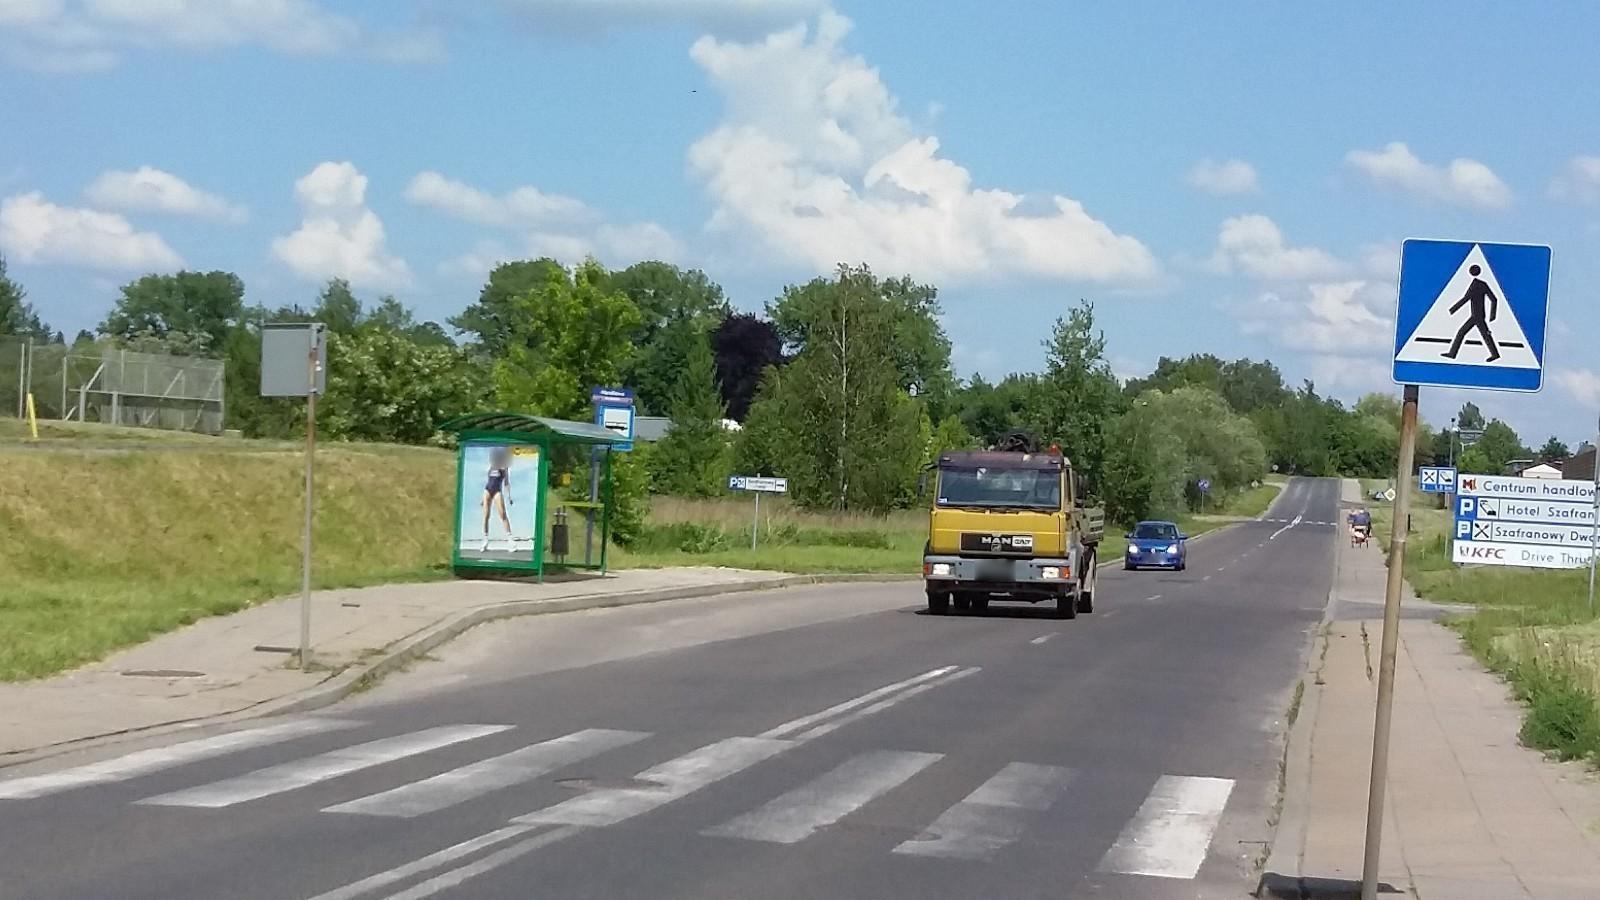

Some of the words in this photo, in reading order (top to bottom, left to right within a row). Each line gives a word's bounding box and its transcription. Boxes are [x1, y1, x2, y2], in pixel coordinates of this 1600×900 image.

[1483, 481, 1536, 493] Centrum
[1542, 484, 1596, 496] handlow
[1507, 505, 1540, 516] Hotel
[1548, 507, 1595, 518] Szafran
[981, 536, 1011, 544] MAN
[1495, 527, 1565, 542] Szafranowy
[1471, 547, 1505, 559] KFC
[1521, 550, 1554, 562] Drive
